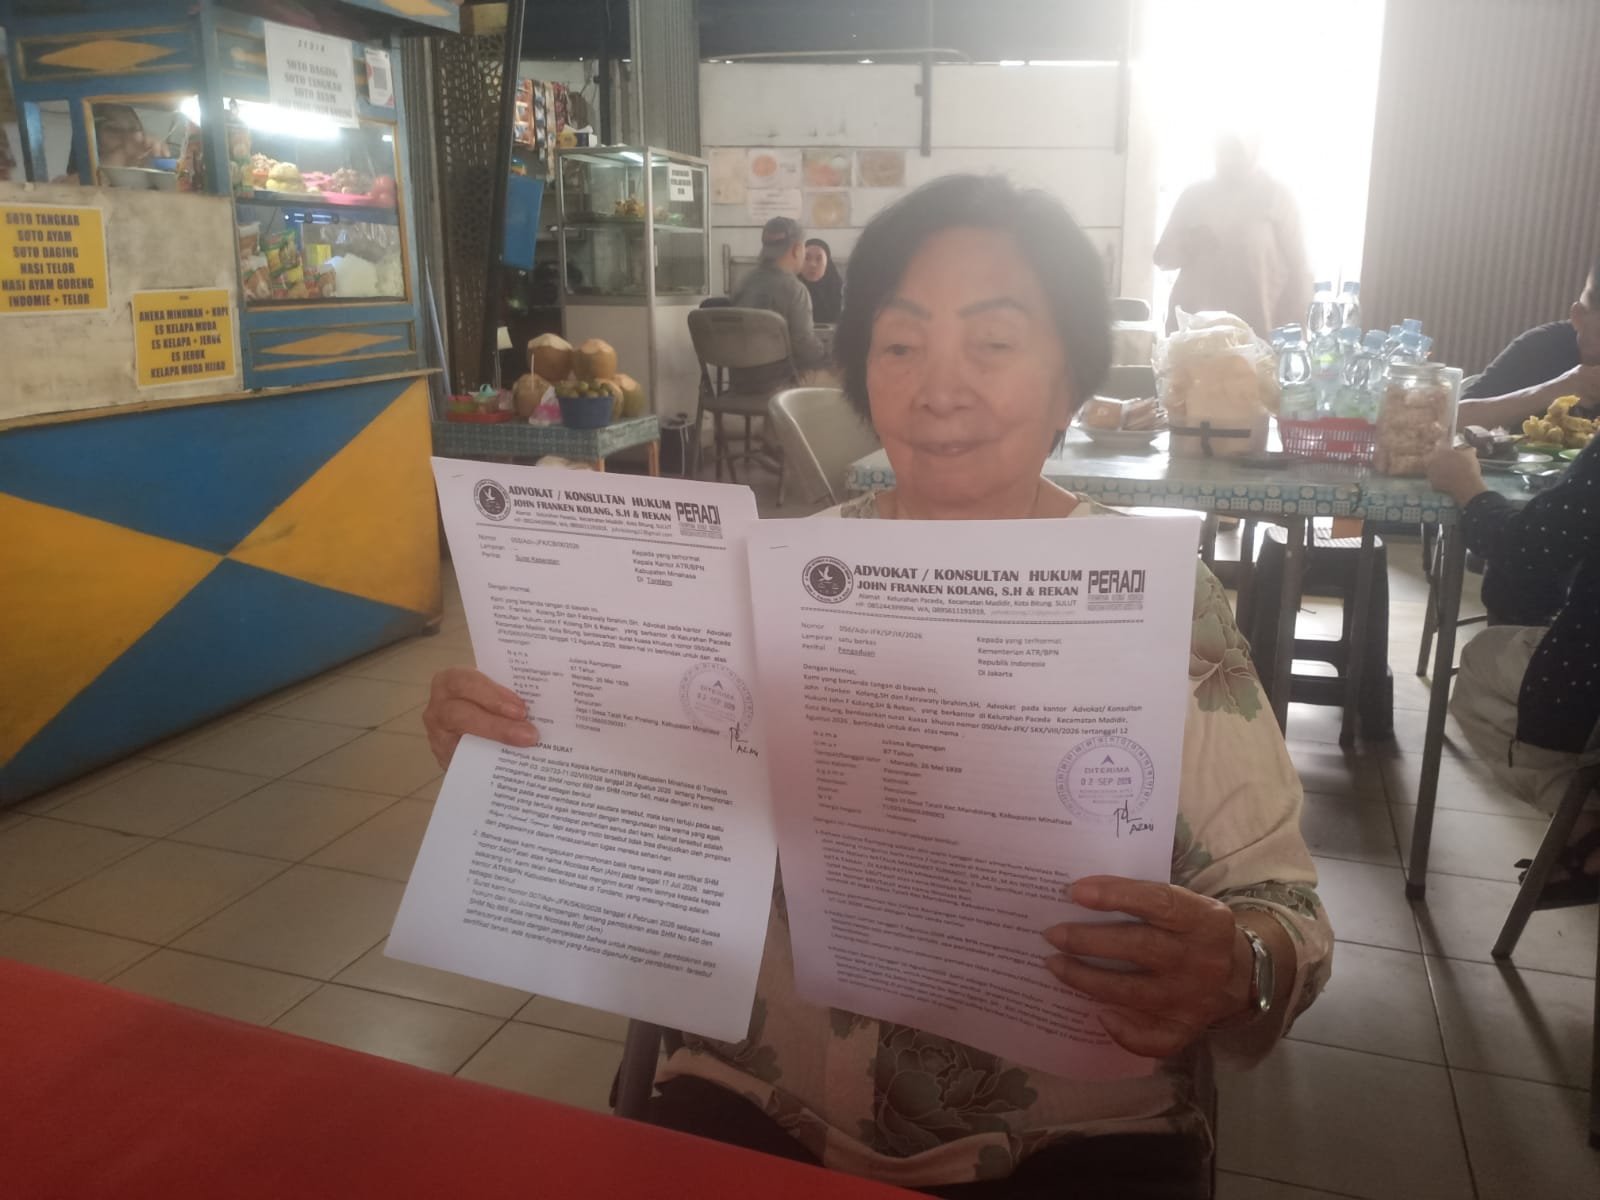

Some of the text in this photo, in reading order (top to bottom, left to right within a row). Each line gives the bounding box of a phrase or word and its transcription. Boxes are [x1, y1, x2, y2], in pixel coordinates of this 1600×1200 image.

[6, 212, 80, 226] SOTO TANGKAR
[17, 230, 72, 242] SOTO AYAM
[13, 246, 79, 258] SOTO DAGING
[20, 262, 75, 274] NASI TELOR
[2, 278, 94, 291] NASI AYAM GORENG
[9, 295, 50, 307] INDOMIE
[62, 293, 90, 306] TELOR
[139, 310, 165, 322] ANEKA
[155, 321, 217, 335] ES KELAPA MUDA
[151, 339, 161, 350] ES
[163, 336, 191, 349] KELAPA
[171, 351, 181, 362] ES
[151, 366, 180, 378] KELAPA
[181, 363, 203, 375] MUDA
[509, 486, 554, 499] ADVOKAT
[564, 491, 625, 505] KONSULTAN
[631, 497, 672, 509] HUKUM
[514, 500, 534, 509] JOHN
[537, 502, 575, 512] FRANKEN
[577, 506, 613, 517] KOLANG,
[616, 509, 630, 517] S.H
[642, 511, 672, 520] REKAN
[675, 501, 721, 524] PERADI
[854, 566, 1083, 581] ADVOKAT / KONSULTAN HUKUM
[1087, 569, 1146, 594] PERADI
[857, 581, 1079, 597] JOHN FRANKEN KOLANG, S.H & REKAN
[977, 636, 1004, 644] Kepada
[1025, 648, 1060, 657] ATR/BPN
[978, 659, 1009, 667] Republik
